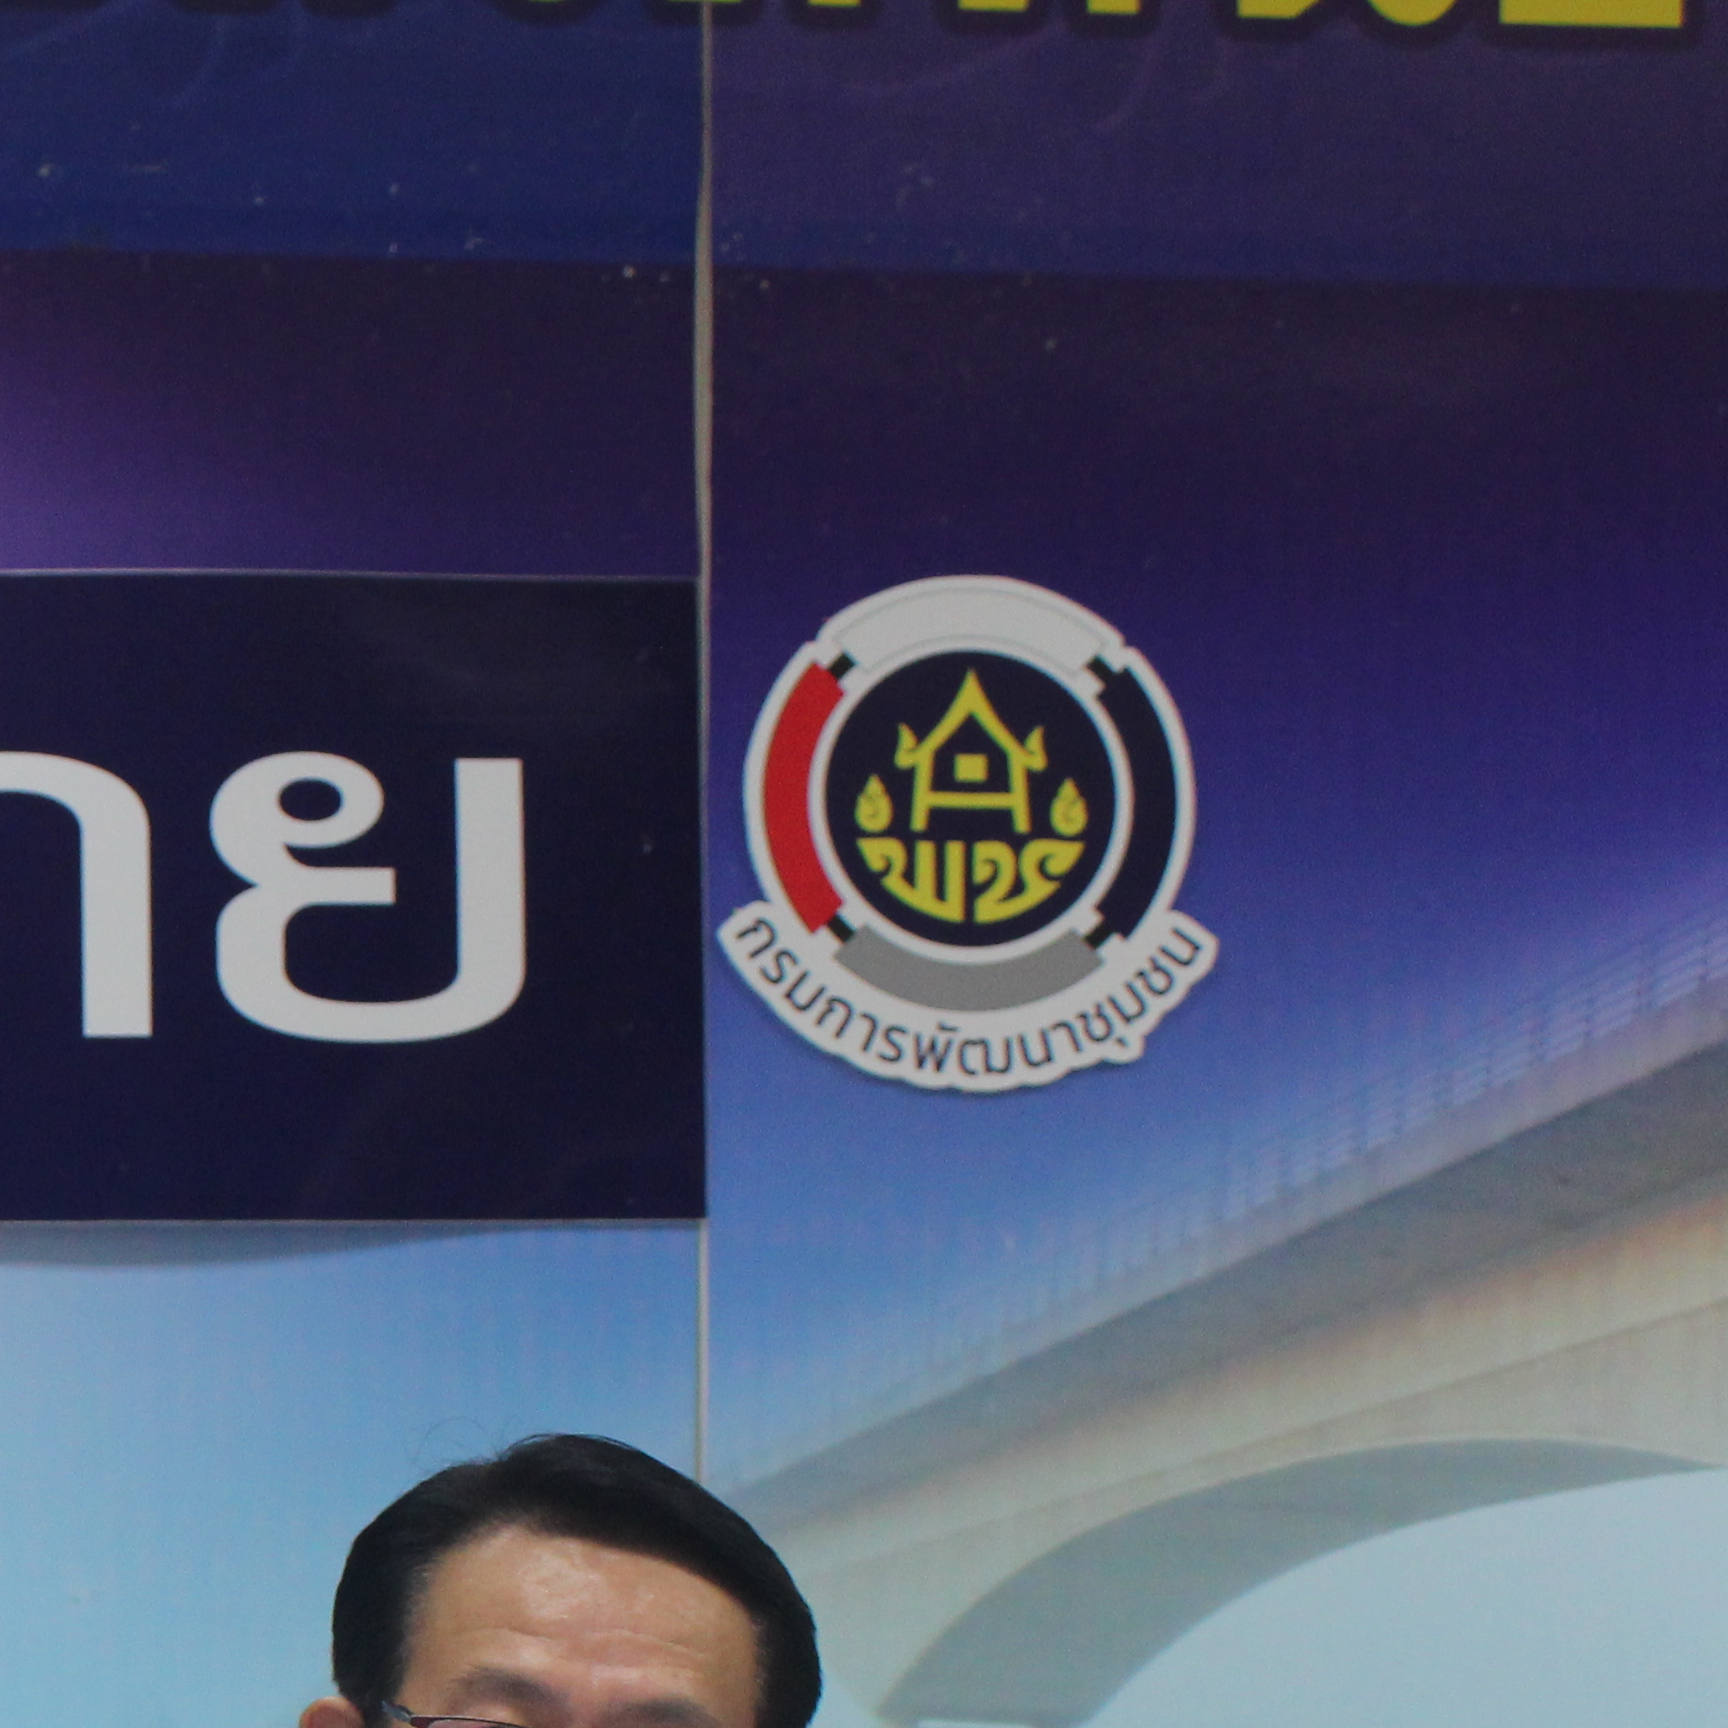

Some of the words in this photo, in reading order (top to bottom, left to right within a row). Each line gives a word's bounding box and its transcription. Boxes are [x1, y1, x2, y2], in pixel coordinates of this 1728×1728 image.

[734, 917, 1203, 1077] กรมการพัฒนาชุมชน
